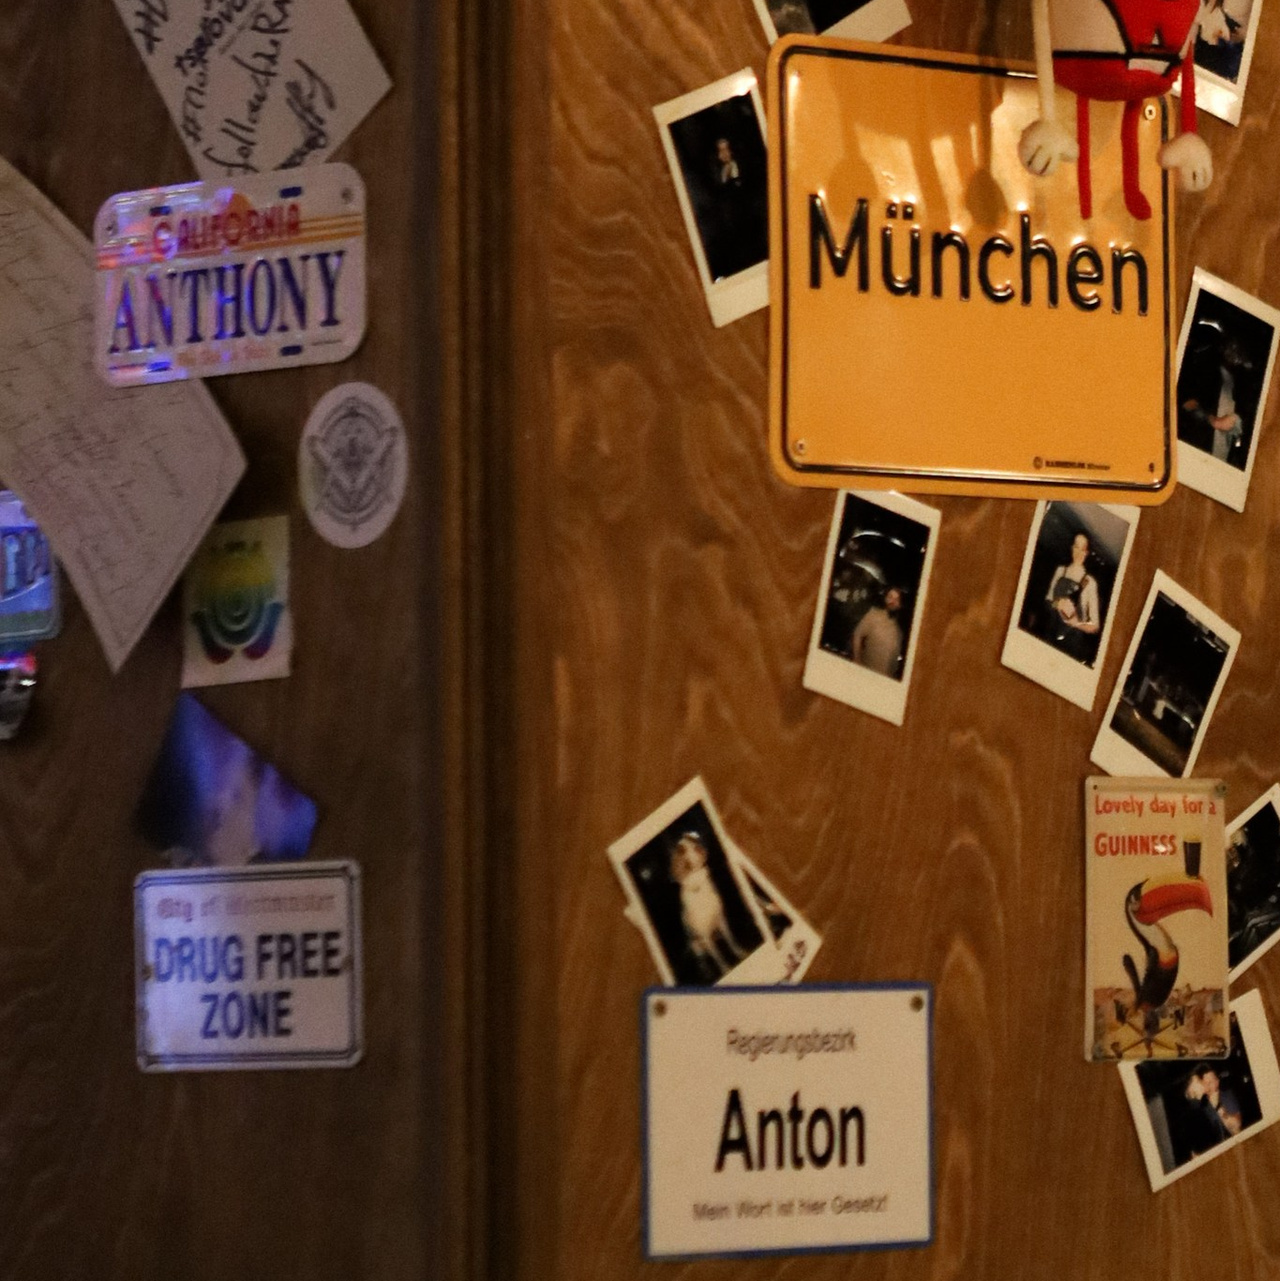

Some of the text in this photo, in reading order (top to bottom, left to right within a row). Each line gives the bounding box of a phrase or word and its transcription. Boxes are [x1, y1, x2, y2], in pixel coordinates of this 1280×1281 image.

[153, 202, 301, 257] CALIFORNIA
[808, 192, 1149, 317] München
[108, 249, 346, 354] ANTHONY
[1094, 793, 1218, 819] Lovely day for a
[1094, 831, 1178, 858] GUINNESS
[154, 931, 342, 983] DRUG FREE
[200, 990, 292, 1039] ZONE
[726, 1026, 858, 1062] Regierungsbezirk
[714, 1088, 866, 1173] Anton
[692, 1201, 731, 1222] Mein
[737, 1199, 772, 1219] Wort
[777, 1198, 793, 1218] ist
[799, 1197, 827, 1217] hier
